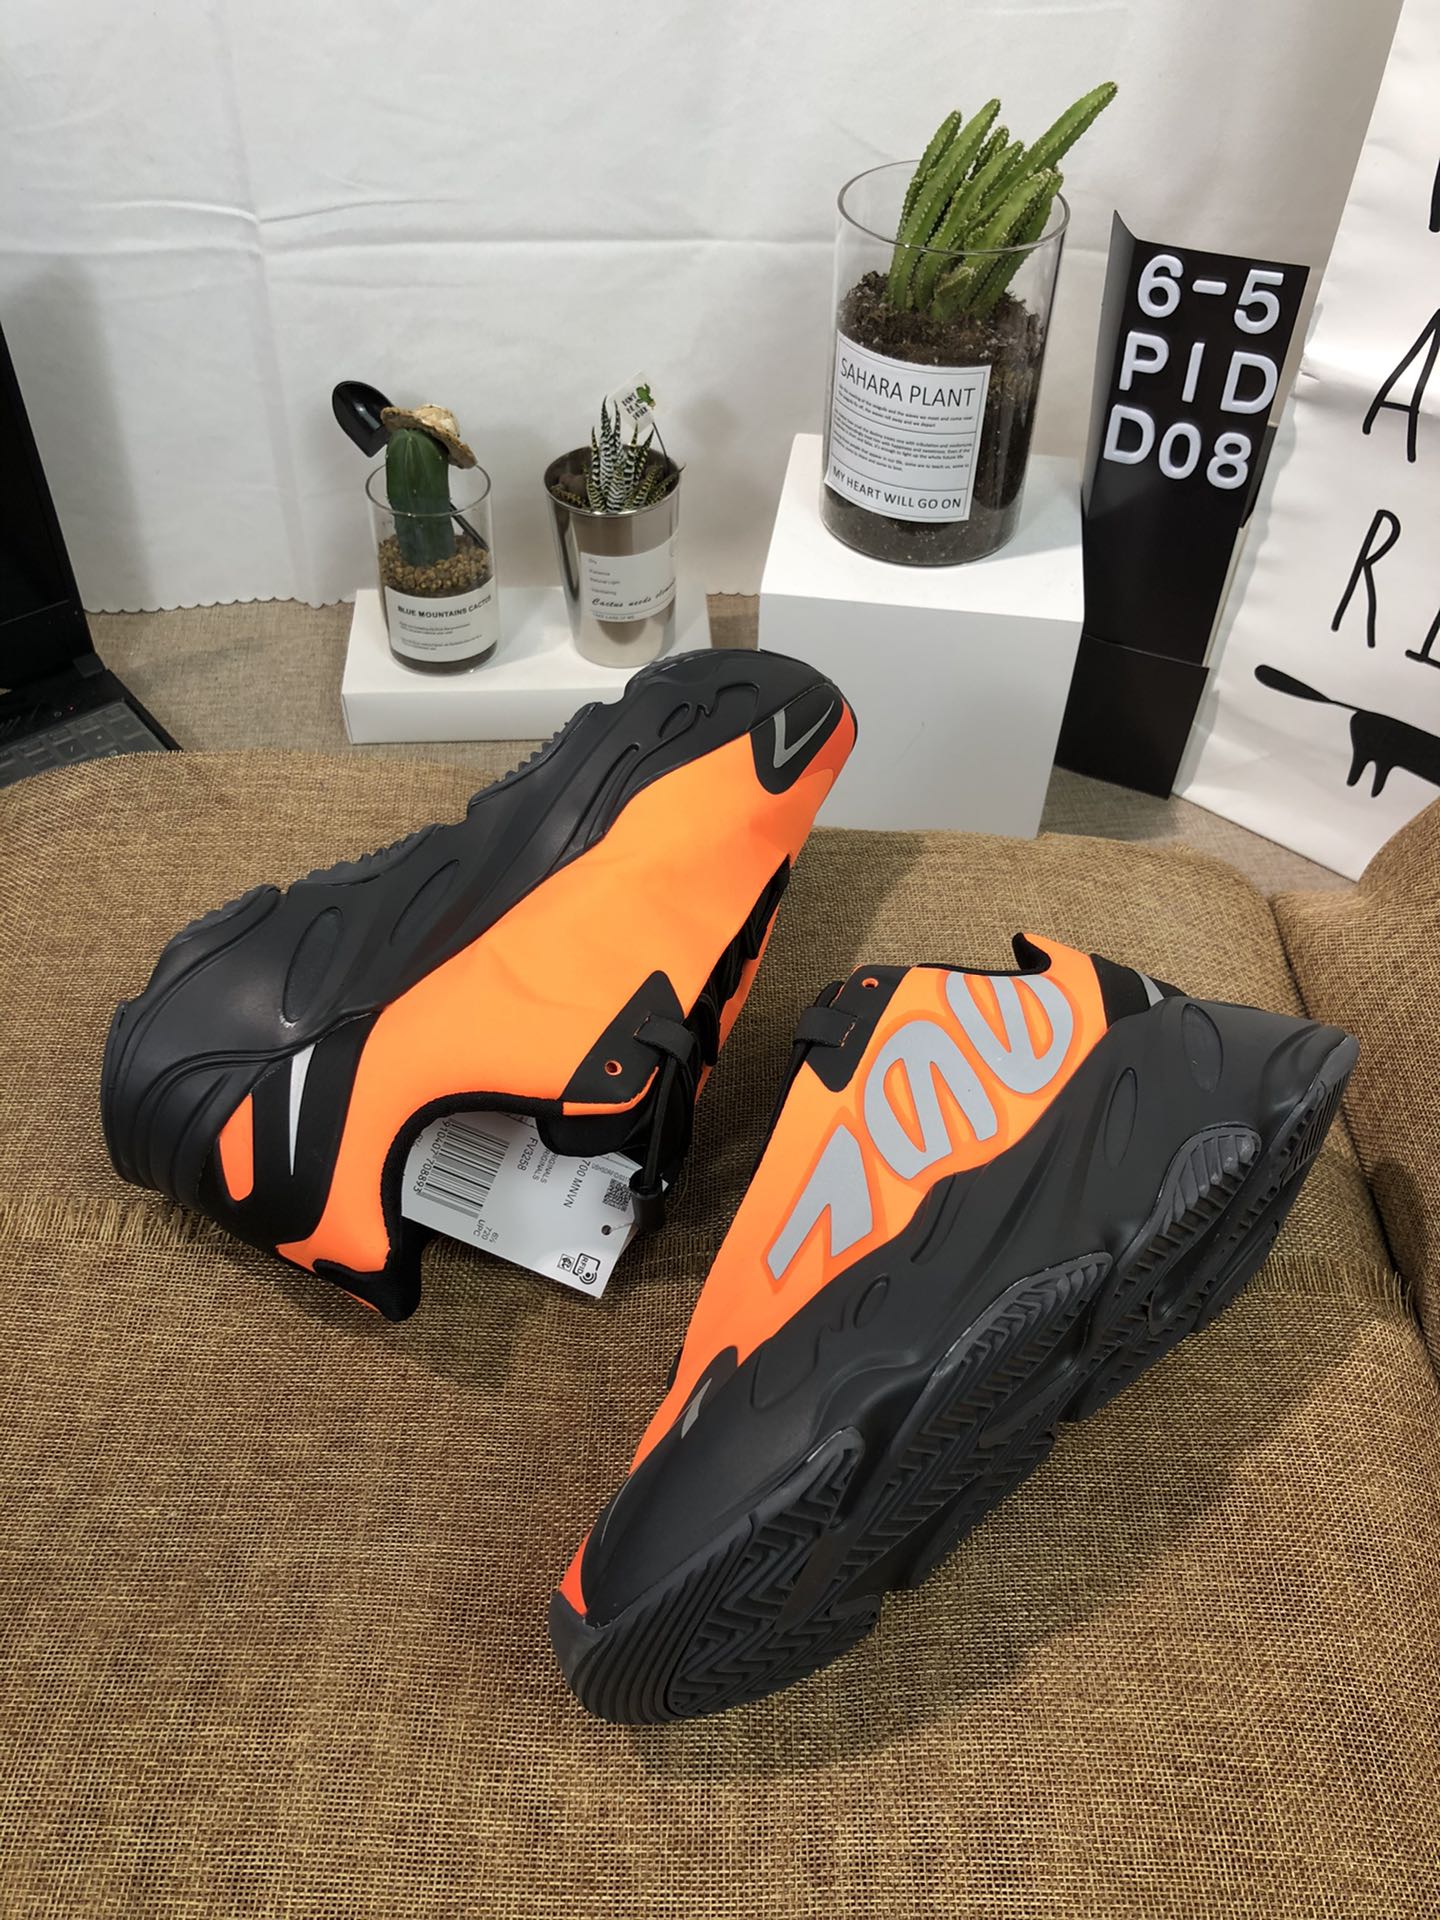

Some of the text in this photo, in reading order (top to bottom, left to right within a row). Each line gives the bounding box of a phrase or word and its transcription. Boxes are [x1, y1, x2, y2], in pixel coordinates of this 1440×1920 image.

[1137, 253, 1284, 335] 6-5
[841, 358, 903, 402] SAHARA
[909, 385, 976, 407] PLANT
[1103, 403, 1252, 490] D08
[832, 466, 962, 510] MY HEART WILL GO ON
[397, 605, 417, 616] BLUE
[418, 608, 468, 618] MOUNTAINS
[592, 597, 624, 608] Cactus
[517, 1136, 539, 1171] FV3258
[532, 1150, 552, 1182] RIGINALS
[413, 1158, 434, 1194] 708893
[563, 1159, 591, 1209] 700 MNVN
[473, 1219, 486, 1237] UPC
[481, 1226, 494, 1241] 720
[576, 1255, 588, 1275] RFID
